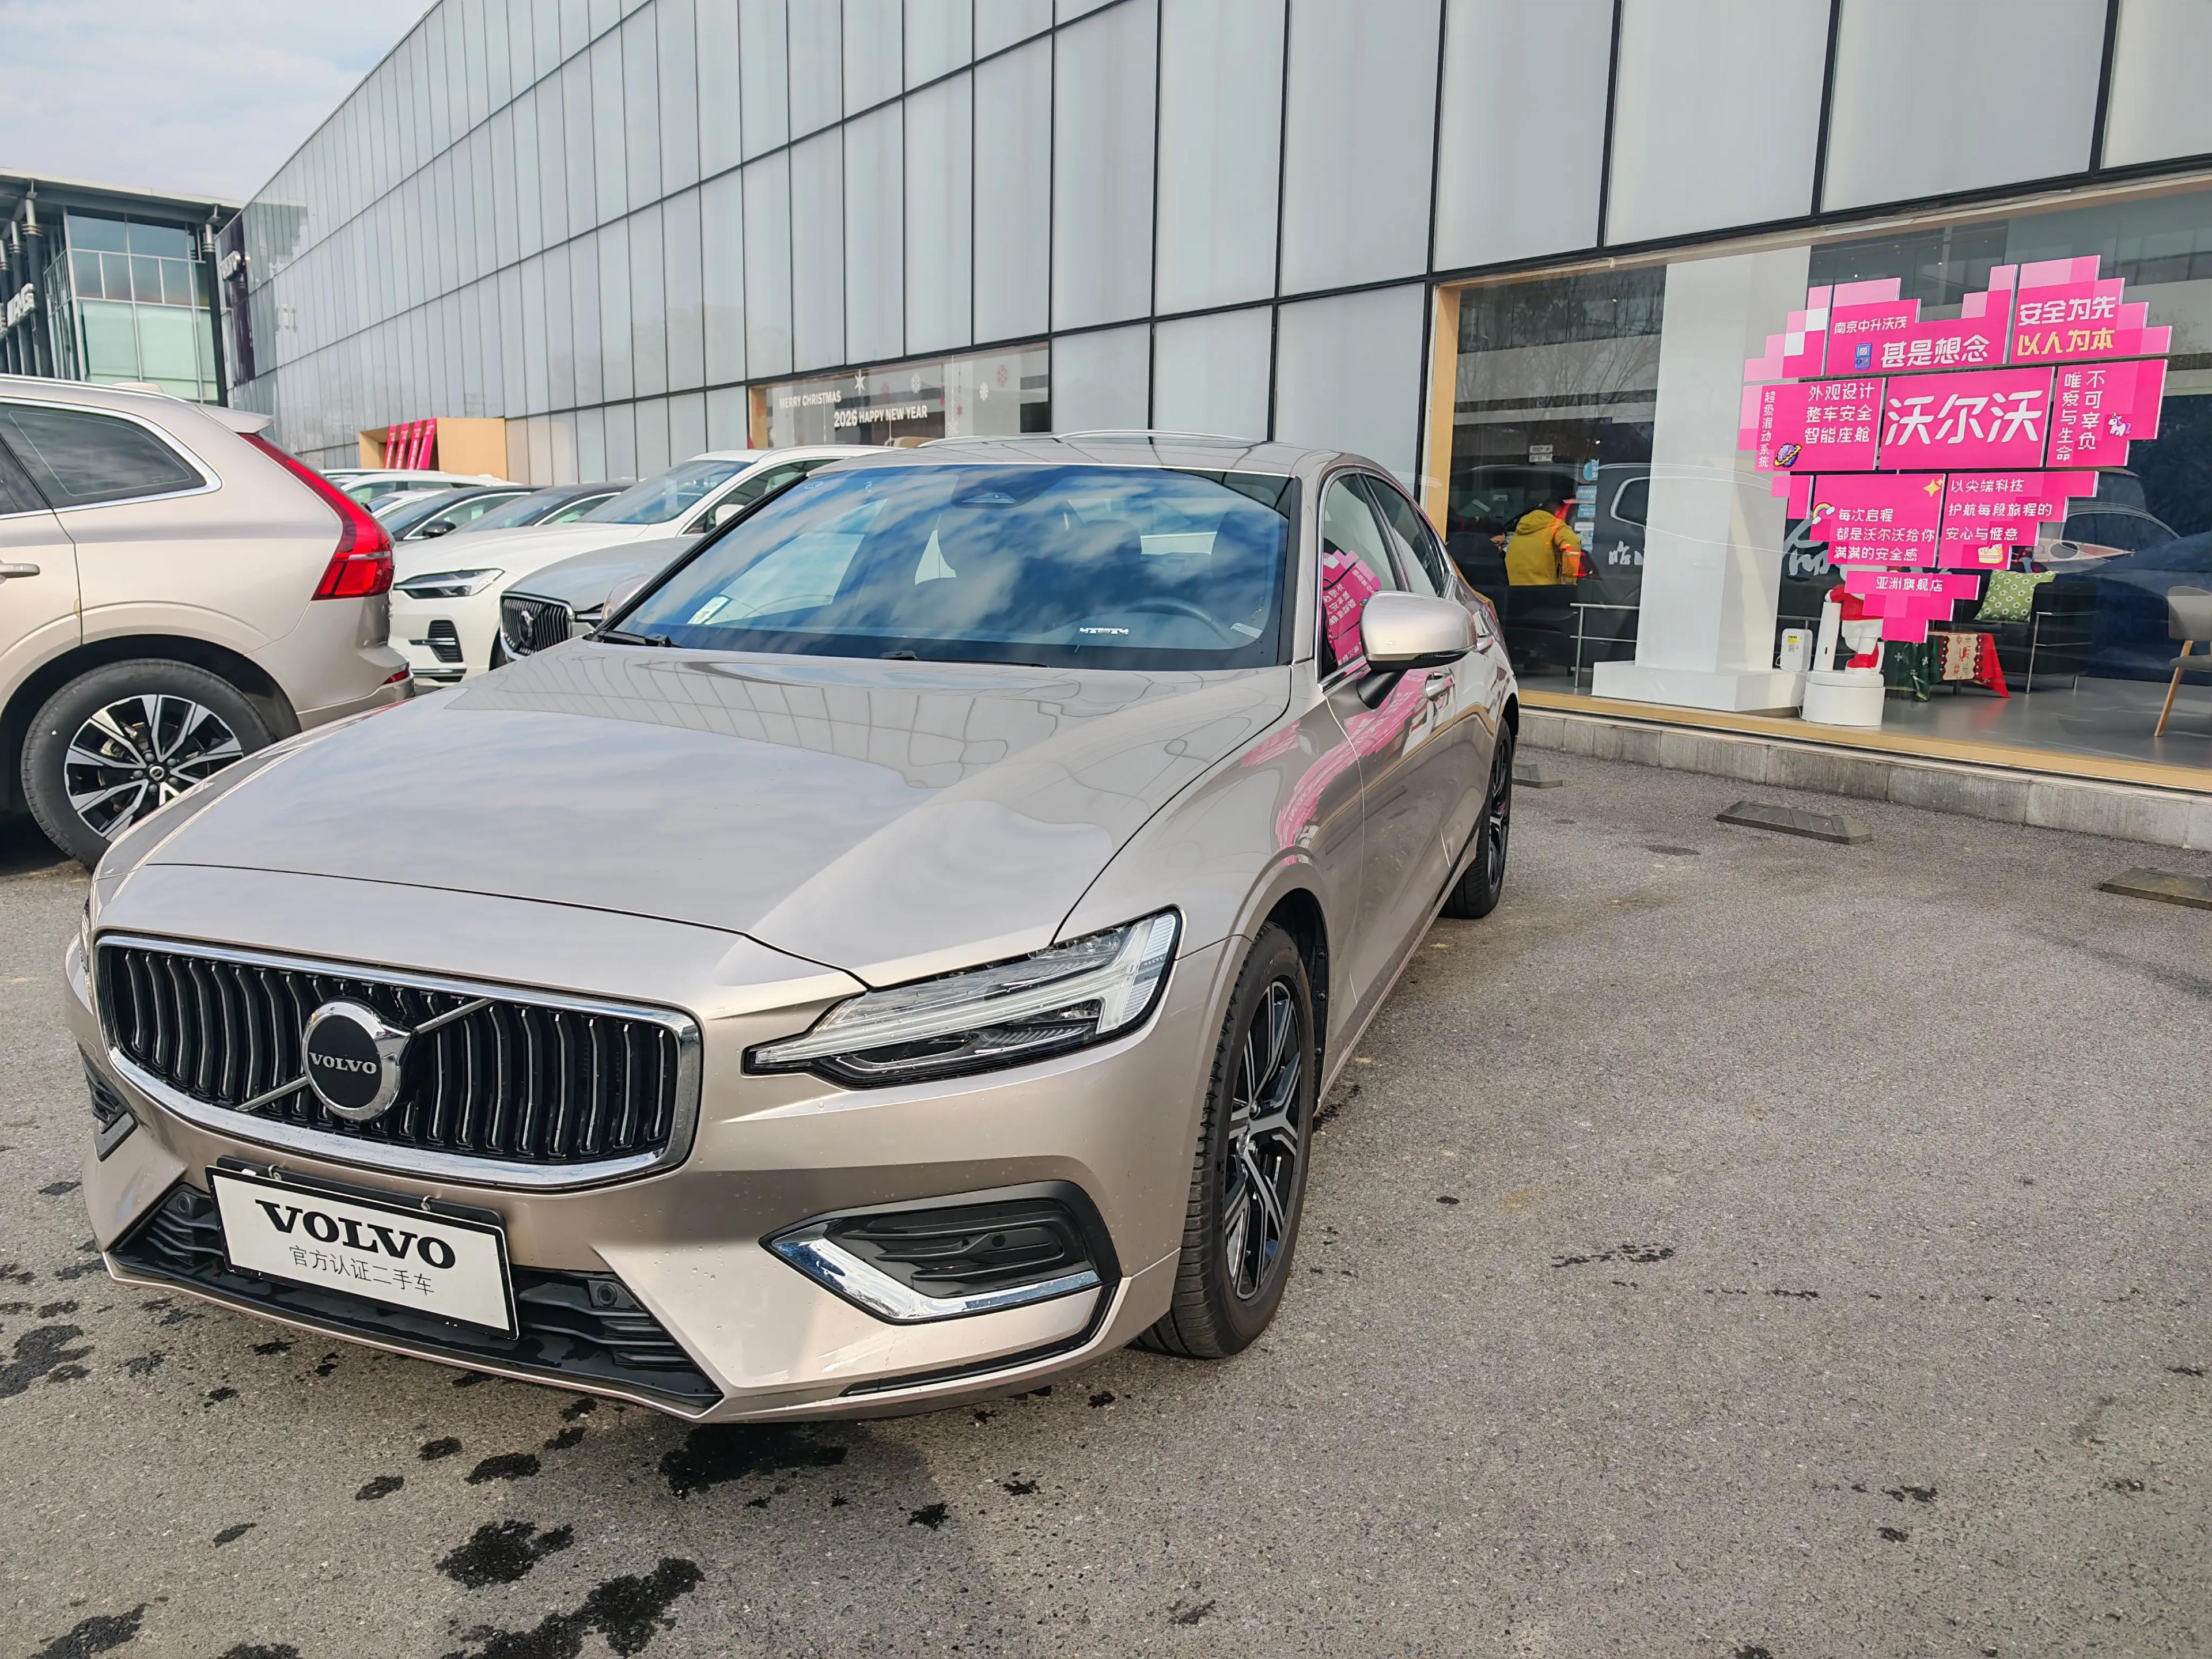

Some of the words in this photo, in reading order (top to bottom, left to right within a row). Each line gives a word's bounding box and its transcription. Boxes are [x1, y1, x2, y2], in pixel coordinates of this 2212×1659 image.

[2018, 296, 2116, 326] 安全为先
[1834, 316, 1907, 335] 南京中升沃茂
[1881, 334, 1990, 368] 甚是想念
[2017, 327, 2115, 356] 以人为本
[779, 395, 801, 409] MERRY
[802, 391, 842, 407] CHRISTMAS
[1808, 382, 1875, 402] 外观设计
[834, 410, 858, 427] 2026
[859, 409, 884, 423] HAPPY
[885, 407, 904, 421] NEW
[906, 405, 927, 419] YEAR
[1806, 404, 1872, 423] 整车安全
[1885, 390, 2043, 445] 沃尔沃
[2056, 372, 2082, 461] 唯爱与生命
[1758, 391, 1775, 468] 超级混动系统
[1804, 426, 1870, 444] 智能座舱
[1951, 479, 2024, 493] 以尖端科技
[1839, 508, 1893, 522] 每次启程
[1948, 503, 2052, 516] 护航每段旅程的
[1836, 527, 1935, 542] 都是沃尔沃给你
[1945, 527, 2018, 541] 安心与惬意
[1834, 546, 1918, 562] 满满的安全感
[1876, 577, 1944, 592] 亚洲旗舰店
[309, 1052, 377, 1074] VOLVO
[255, 1199, 456, 1269] VOLVO
[289, 1245, 434, 1296] 官方认证二手车
